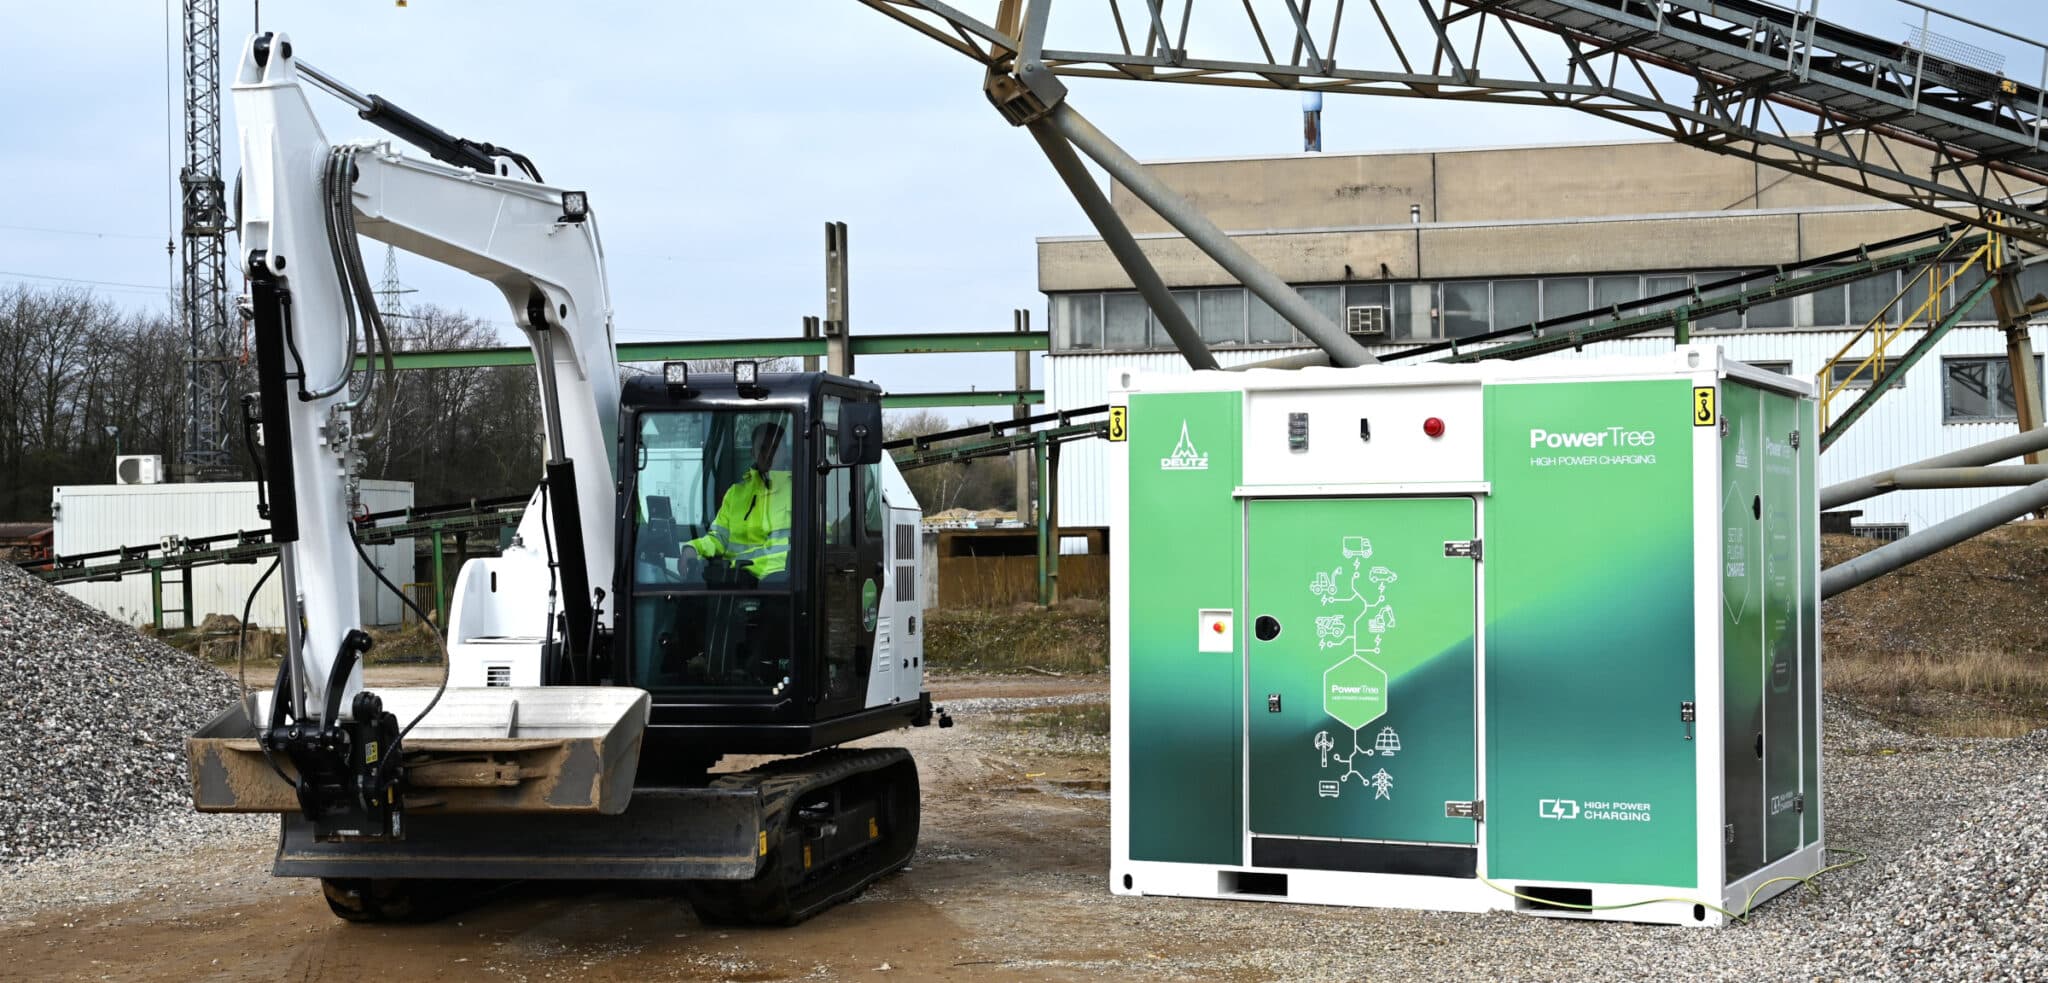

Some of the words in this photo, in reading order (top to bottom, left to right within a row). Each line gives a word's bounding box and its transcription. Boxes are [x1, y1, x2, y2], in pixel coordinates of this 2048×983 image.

[1530, 426, 1655, 448] PowerTree
[1161, 457, 1208, 467] DEUTZ
[1530, 457, 1556, 467] HIGH
[1558, 455, 1598, 466] POWER
[1600, 454, 1656, 465] CHARGING
[1584, 801, 1610, 810] HIGH
[1613, 802, 1651, 811] POWER
[1584, 810, 1651, 822] CHARGING
